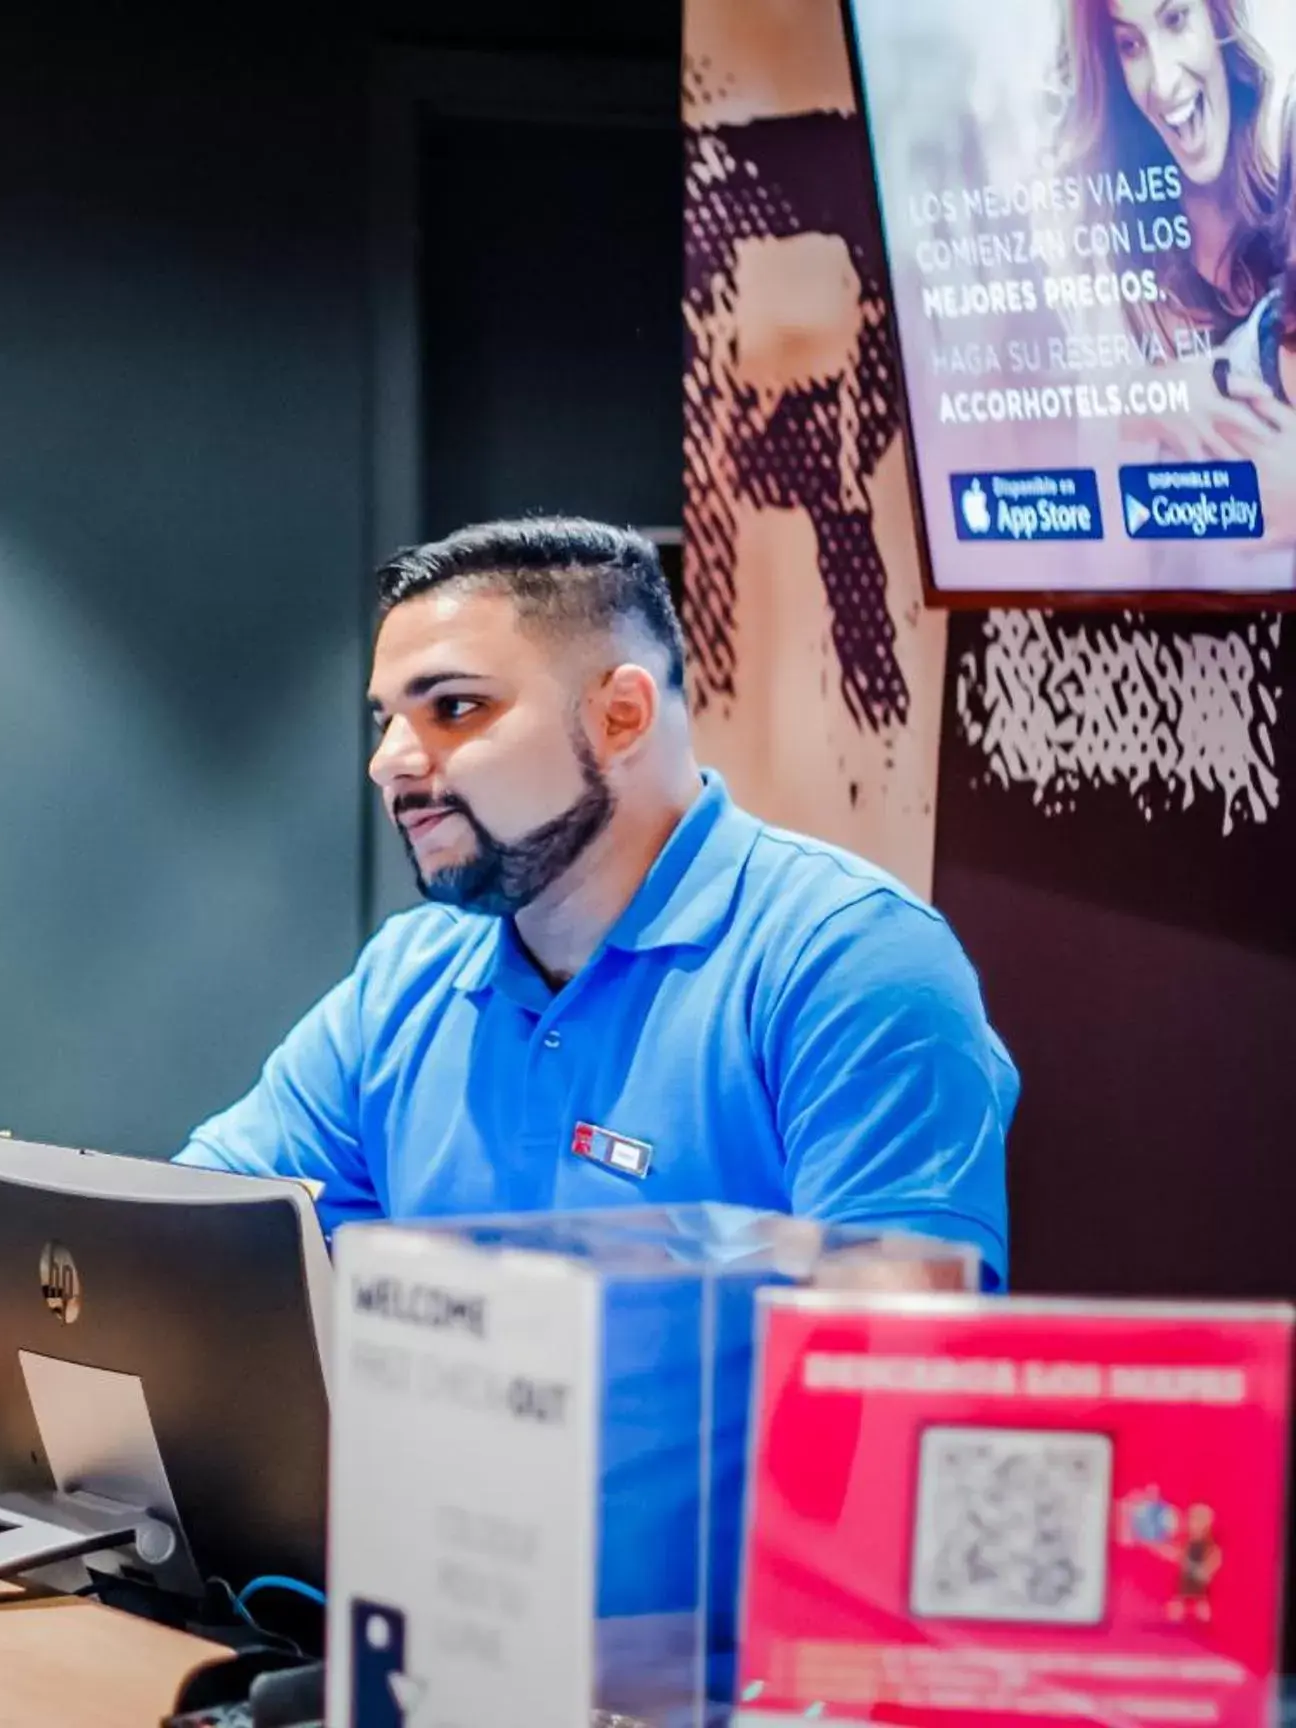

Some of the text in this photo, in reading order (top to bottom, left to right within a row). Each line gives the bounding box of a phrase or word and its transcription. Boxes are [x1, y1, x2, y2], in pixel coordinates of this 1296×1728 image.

[908, 165, 1182, 228] LOS MEJORES VIAJES
[915, 214, 1192, 273] COMIENZAN CON LOS
[921, 267, 1168, 320] MEJORES PRECIOS.
[932, 327, 1213, 376] HAGA SU RESERVA EN
[940, 379, 1190, 424] ACCORHOTELS.COM
[997, 498, 1092, 539] App Store
[1151, 492, 1258, 536] Google play
[42, 1241, 79, 1323] hp
[352, 1275, 487, 1339] WELCOME
